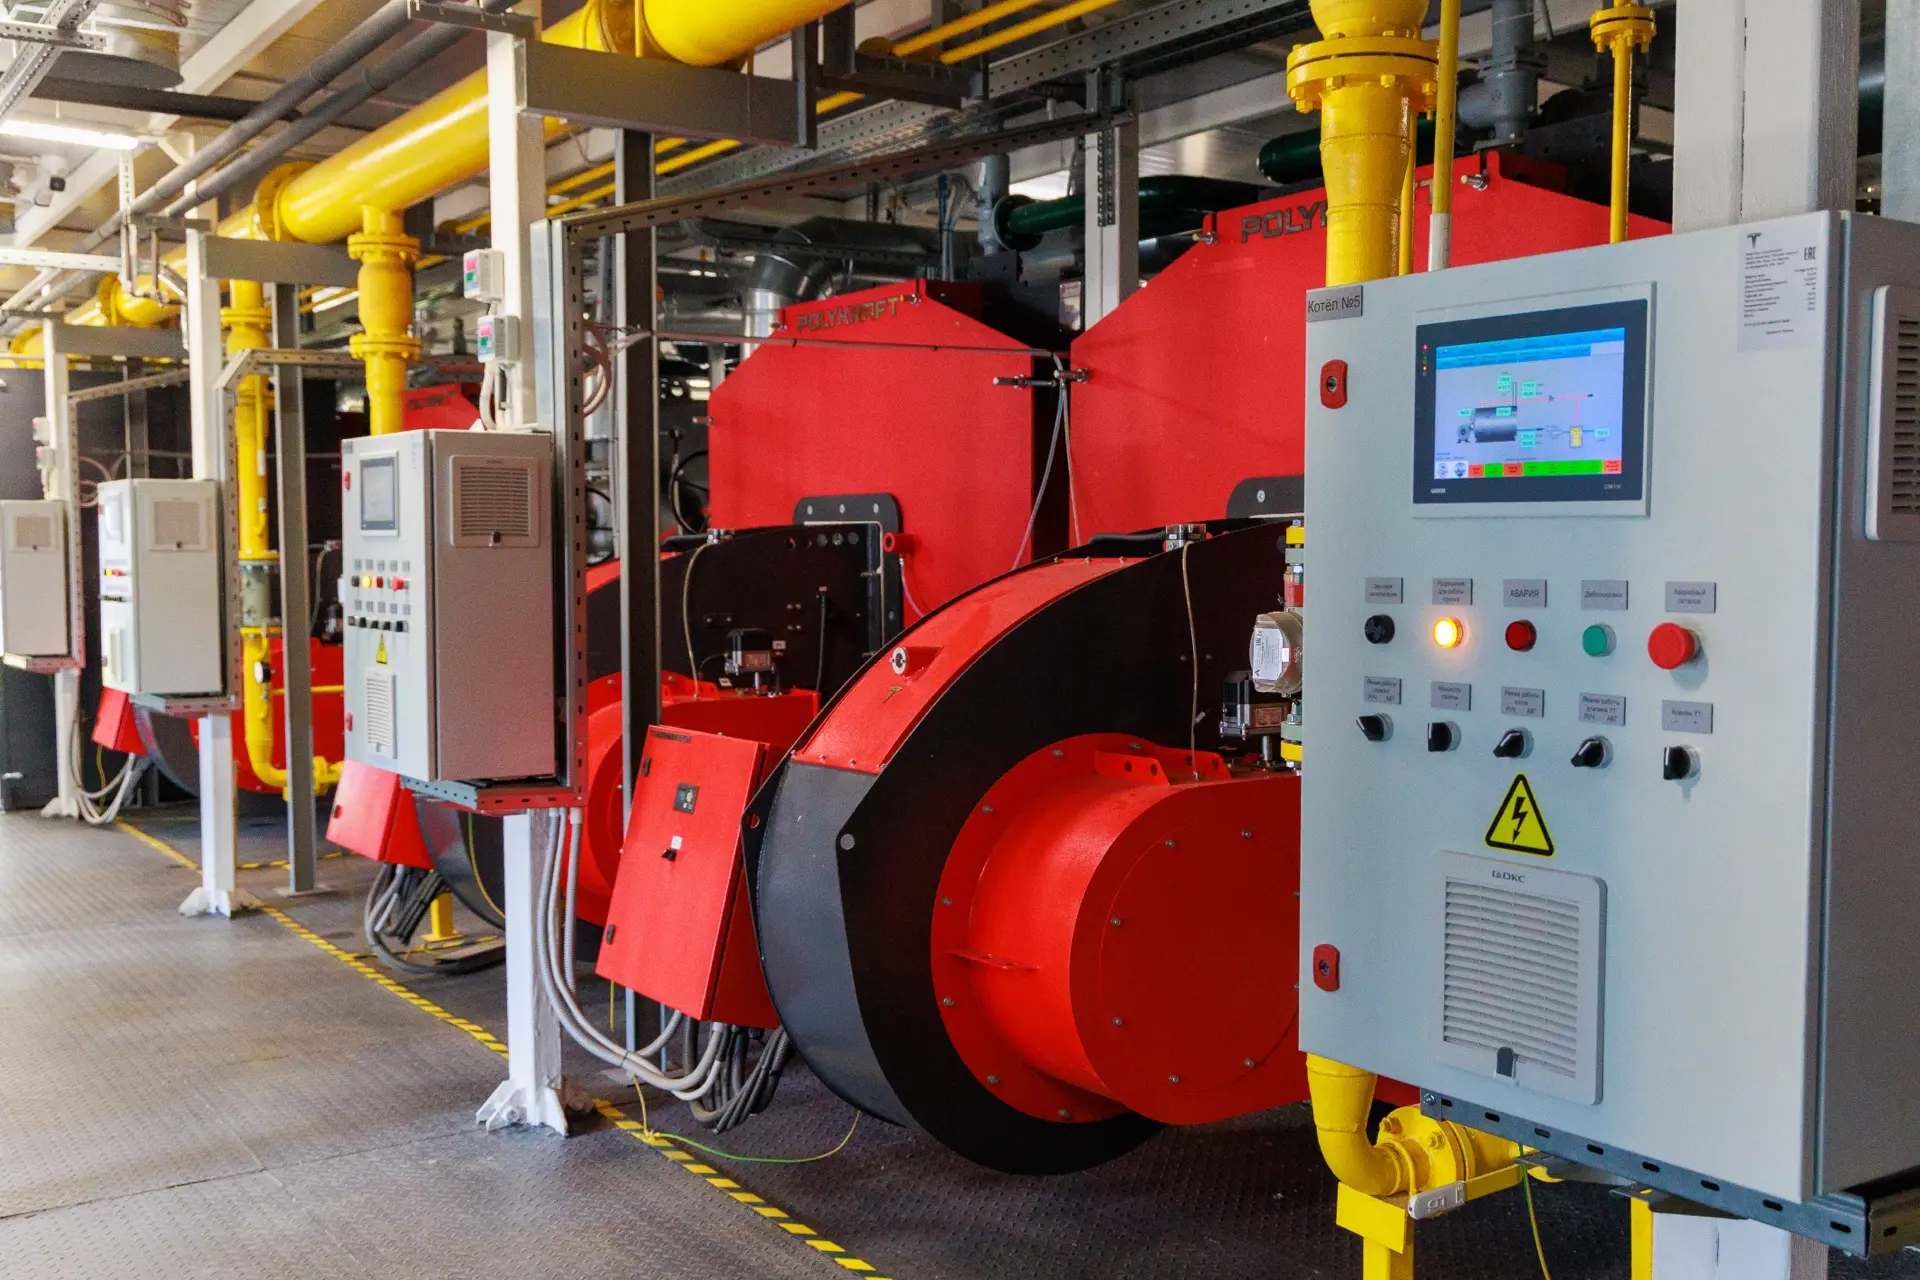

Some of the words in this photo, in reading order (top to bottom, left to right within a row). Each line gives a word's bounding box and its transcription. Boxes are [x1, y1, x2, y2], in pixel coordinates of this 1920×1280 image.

[1308, 298, 1338, 313] Котёл
[1341, 295, 1361, 310] №5
[798, 296, 900, 334] POLYKRAFT
[1509, 589, 1540, 598] АВАРИЯ
